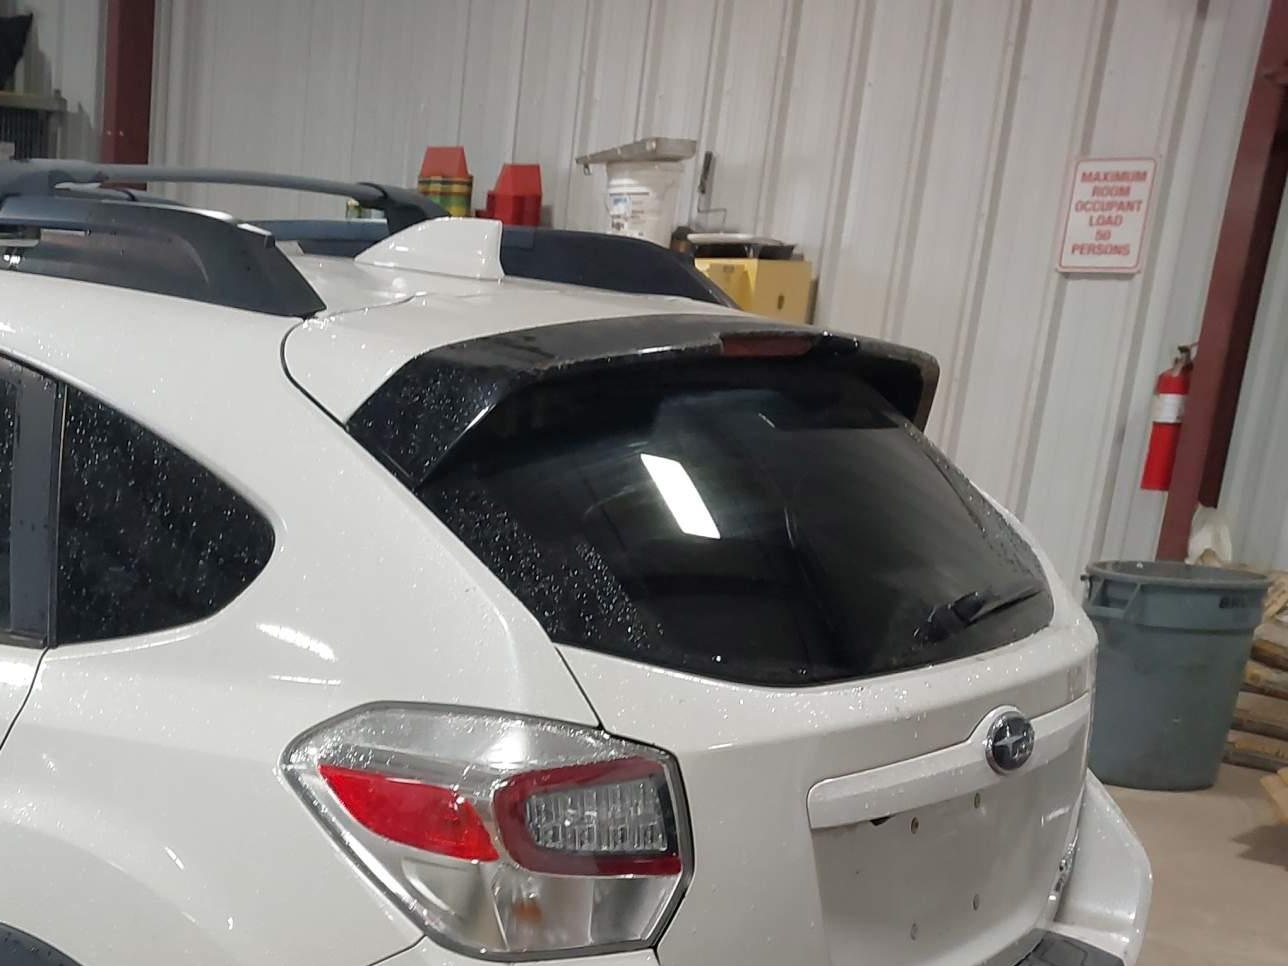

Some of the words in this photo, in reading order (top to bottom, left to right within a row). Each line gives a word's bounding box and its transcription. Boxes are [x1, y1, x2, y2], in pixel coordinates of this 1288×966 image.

[1080, 171, 1147, 182] MAXIMUM
[1091, 185, 1131, 197] ROOM
[1074, 200, 1143, 212] OCCUPANT
[1089, 215, 1123, 226] LOAD
[1095, 229, 1111, 241] 50
[1071, 243, 1130, 256] PERSONS
